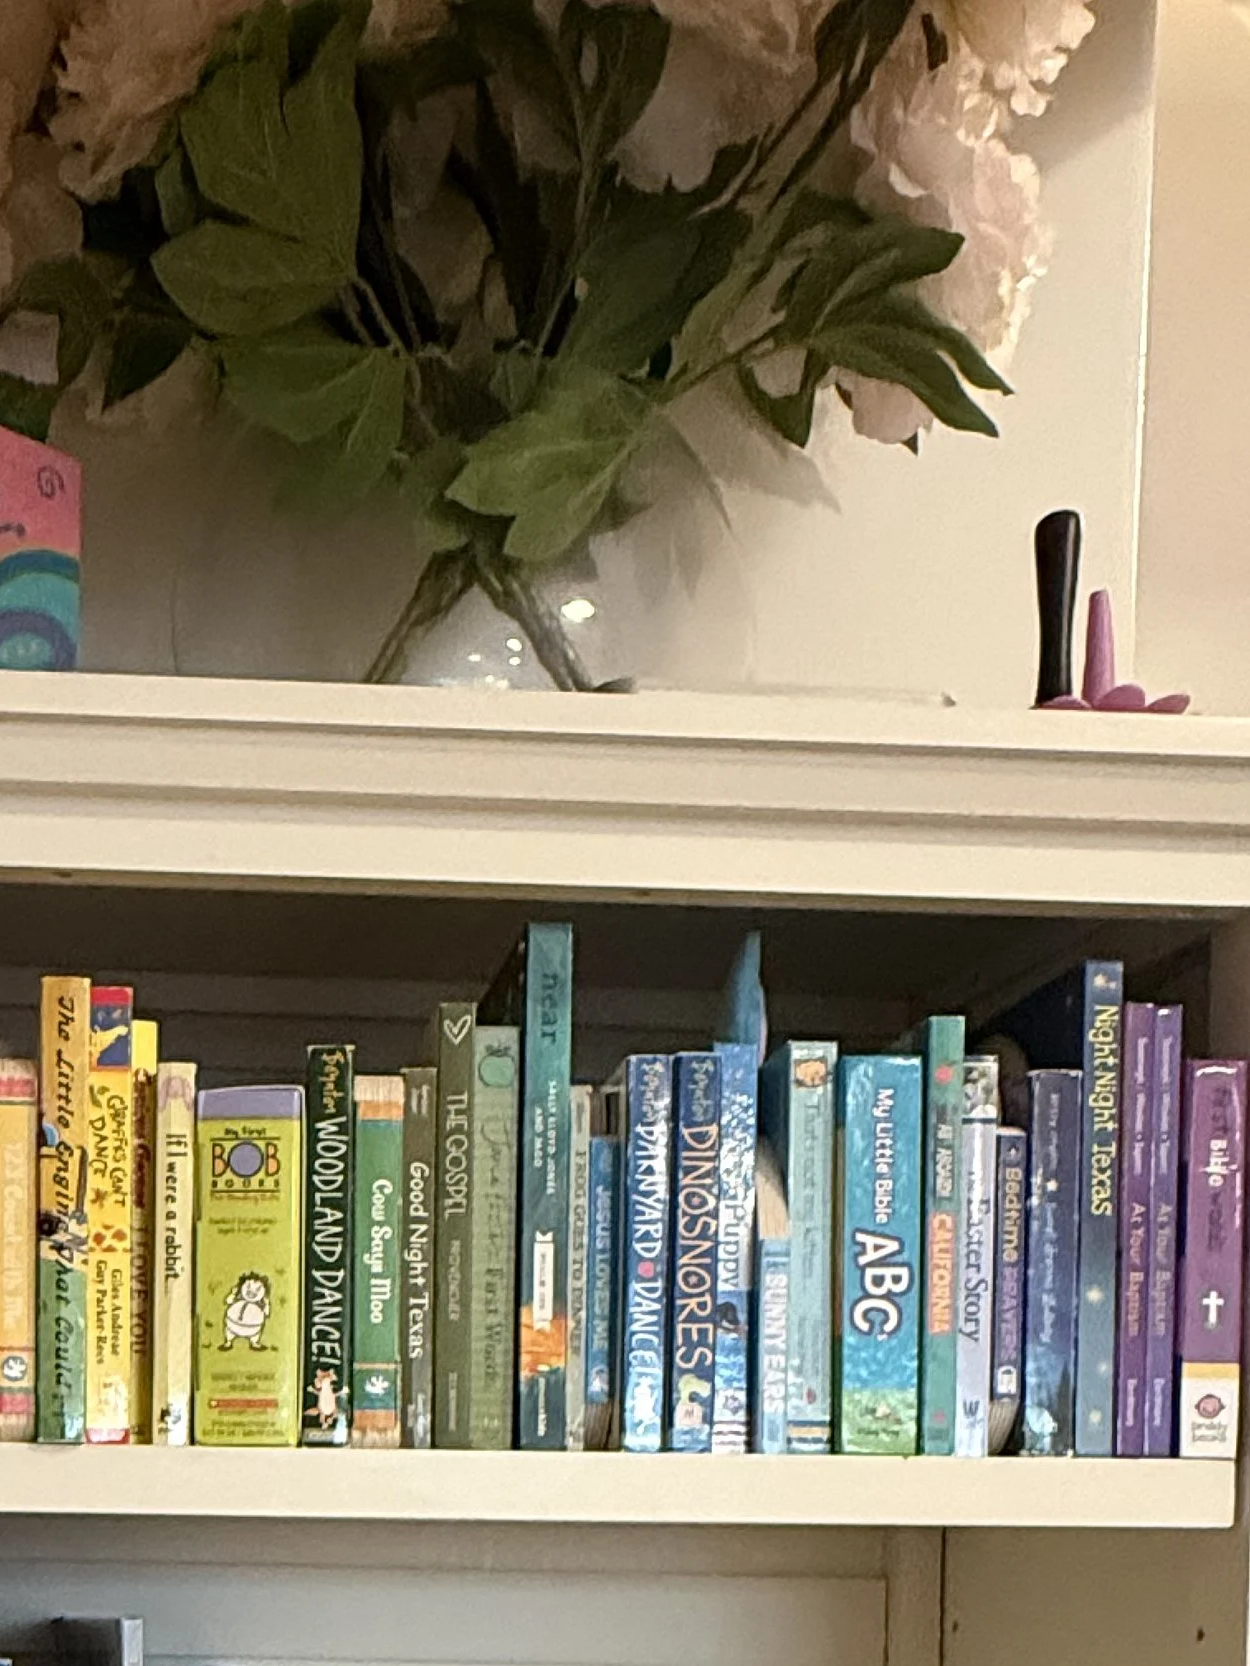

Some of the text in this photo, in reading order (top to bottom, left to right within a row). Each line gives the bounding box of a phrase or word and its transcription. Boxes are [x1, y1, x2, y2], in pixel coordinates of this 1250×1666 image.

[540, 973, 564, 1044] near
[54, 997, 78, 1388] The Little Engine That Could
[92, 1116, 109, 1179] DANCE
[165, 1162, 182, 1203] were
[166, 1134, 188, 1150] If
[445, 1092, 467, 1221] THE GOSPEL
[633, 1122, 665, 1258] BARNYARD
[873, 1088, 893, 1223] My Little Bible
[1092, 1143, 1115, 1216] Texas
[94, 1260, 107, 1285] Guy
[165, 1211, 179, 1221] a
[310, 1116, 344, 1364] WOODLAND DANCE!
[368, 1179, 391, 1323] Cow Says Moo
[405, 1162, 428, 1359] Good Night Texas
[571, 1150, 586, 1282] FROG TO
[676, 1123, 716, 1368] DINOSNORES
[931, 1212, 952, 1333] CALIFORNIA
[960, 1198, 987, 1342] Easter Story
[1002, 1166, 1021, 1262] Bedtime
[1130, 1203, 1146, 1266] At Your
[111, 1269, 122, 1356] Giles Andreae
[764, 1273, 784, 1413] BUNNY EARS
